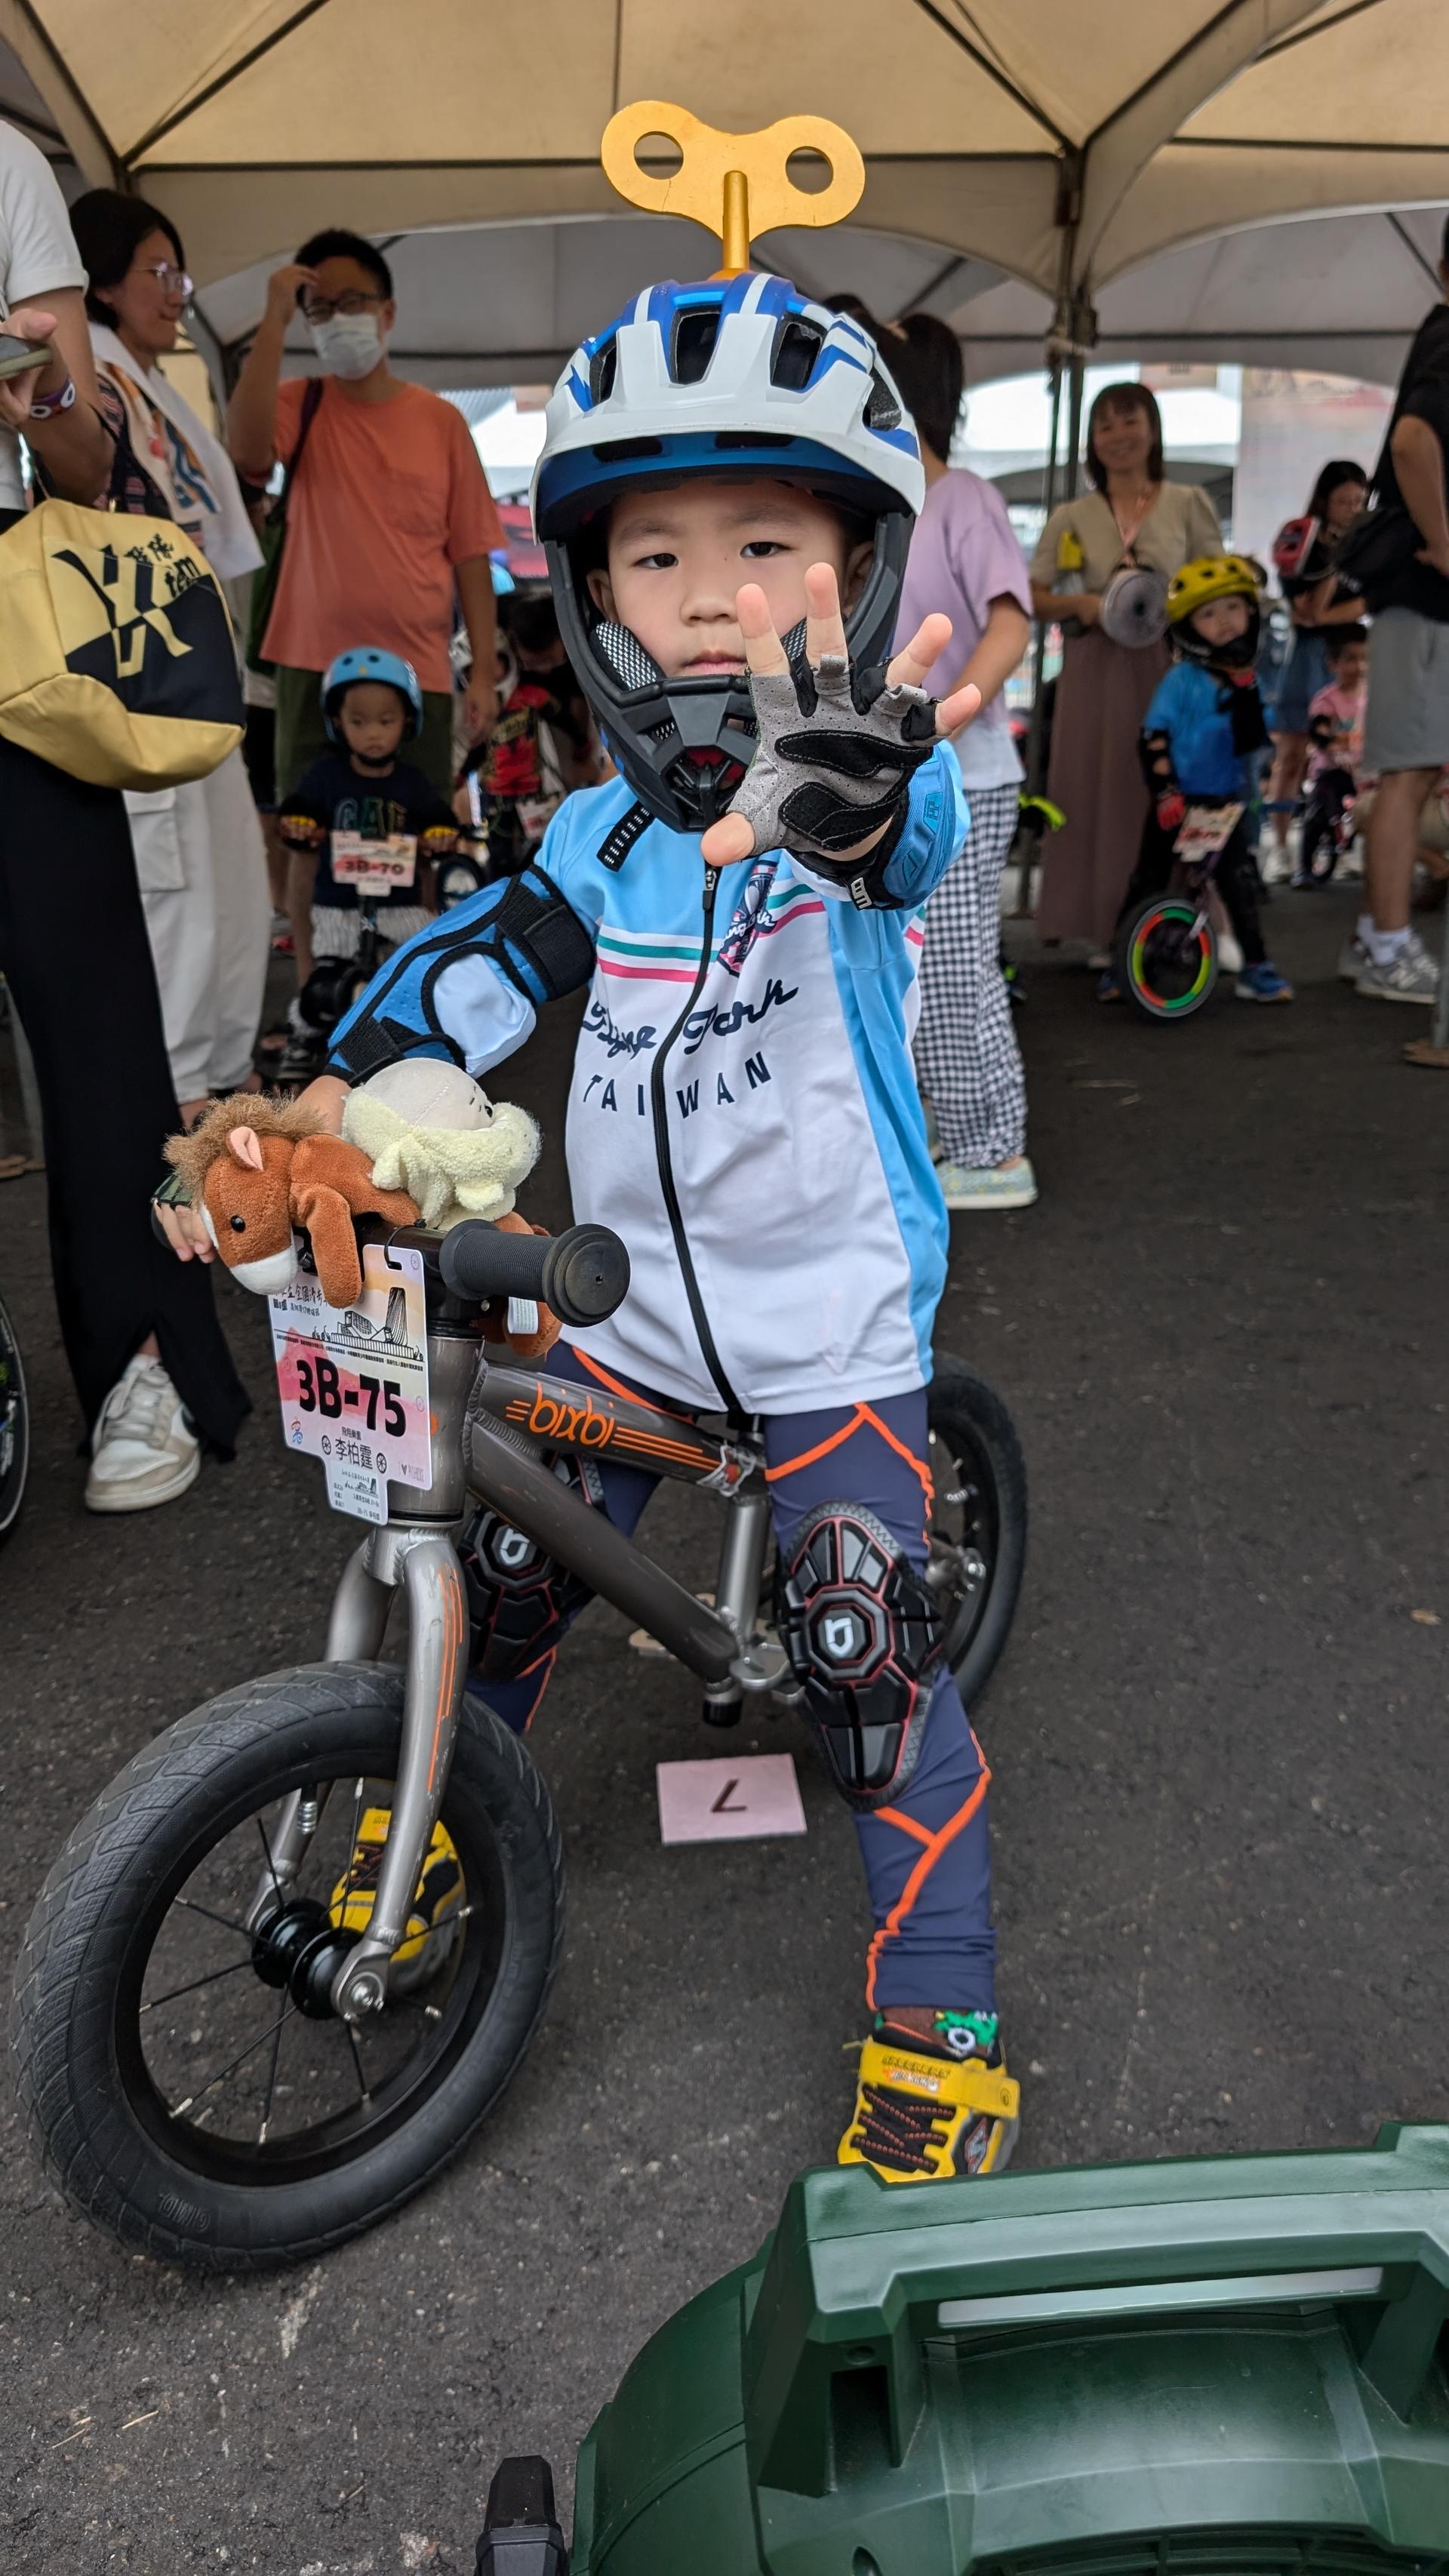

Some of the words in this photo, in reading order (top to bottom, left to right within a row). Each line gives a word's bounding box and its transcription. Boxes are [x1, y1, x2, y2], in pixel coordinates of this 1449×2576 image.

[583, 1051, 772, 1119] TAIWAN
[296, 1356, 406, 1438] 3B-75
[530, 1381, 616, 1448] bixbi
